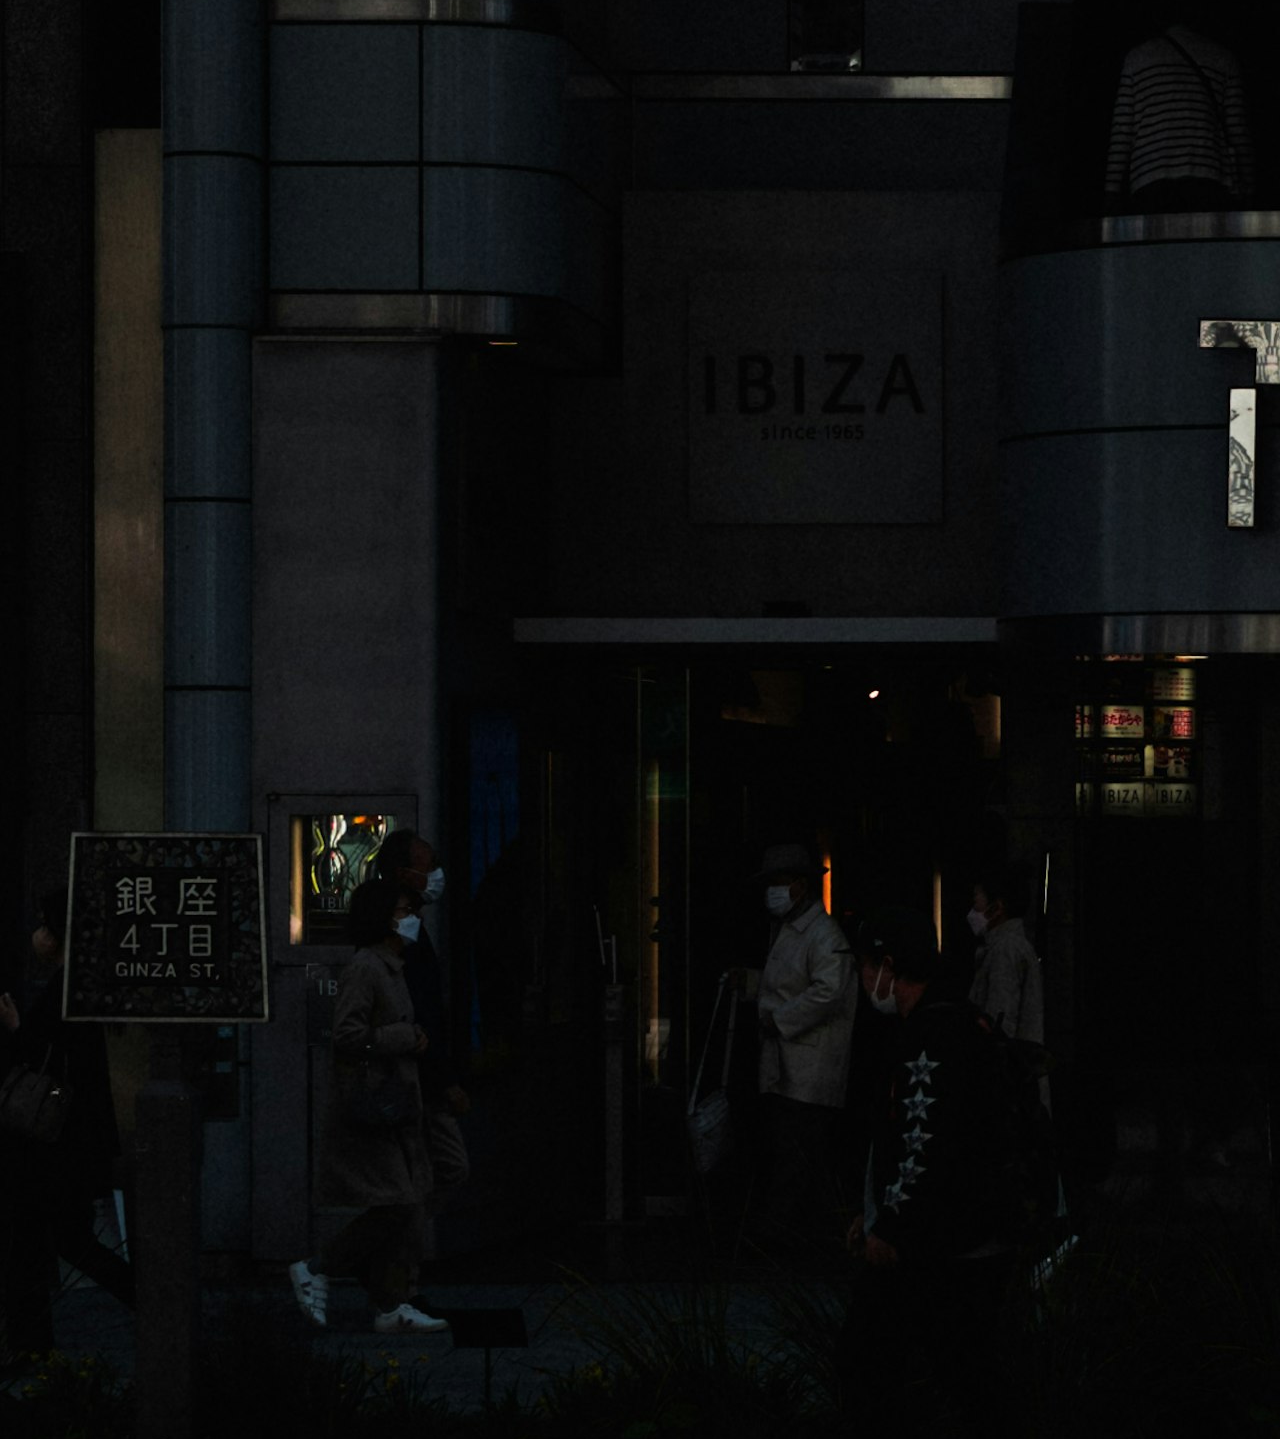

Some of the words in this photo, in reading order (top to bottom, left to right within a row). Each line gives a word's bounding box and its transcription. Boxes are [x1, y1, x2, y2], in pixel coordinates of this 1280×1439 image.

[704, 354, 925, 414] IBIZA
[761, 425, 817, 440] since
[825, 424, 865, 440] 1965
[115, 876, 218, 916] 銀座
[119, 924, 212, 957] 4丁目
[115, 962, 177, 978] GINZA
